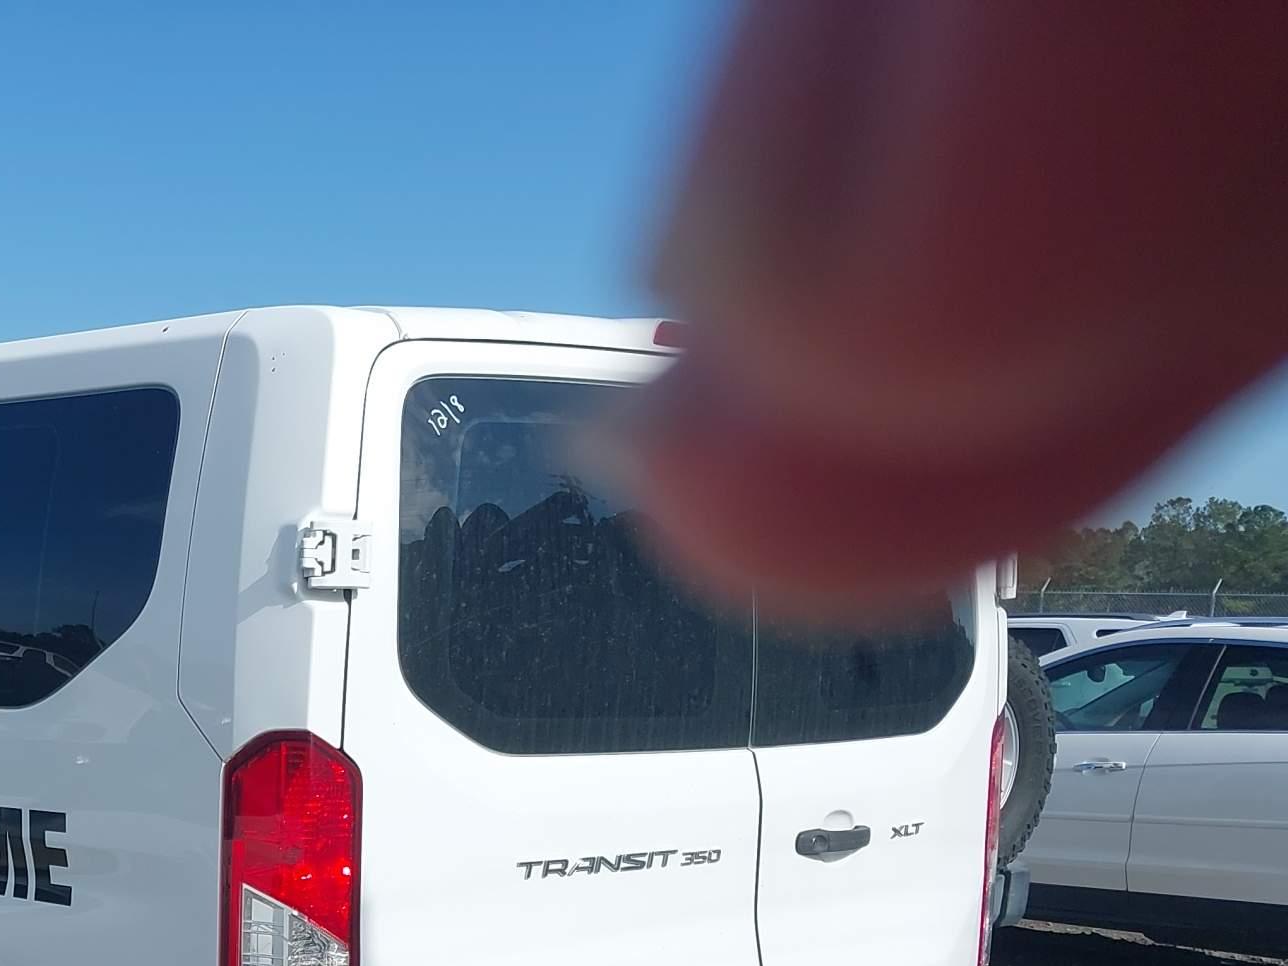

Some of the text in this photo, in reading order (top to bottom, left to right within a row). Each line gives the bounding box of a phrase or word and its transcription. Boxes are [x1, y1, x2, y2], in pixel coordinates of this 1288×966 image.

[890, 821, 925, 840] XLT
[516, 849, 722, 880] TRANSIT 350
